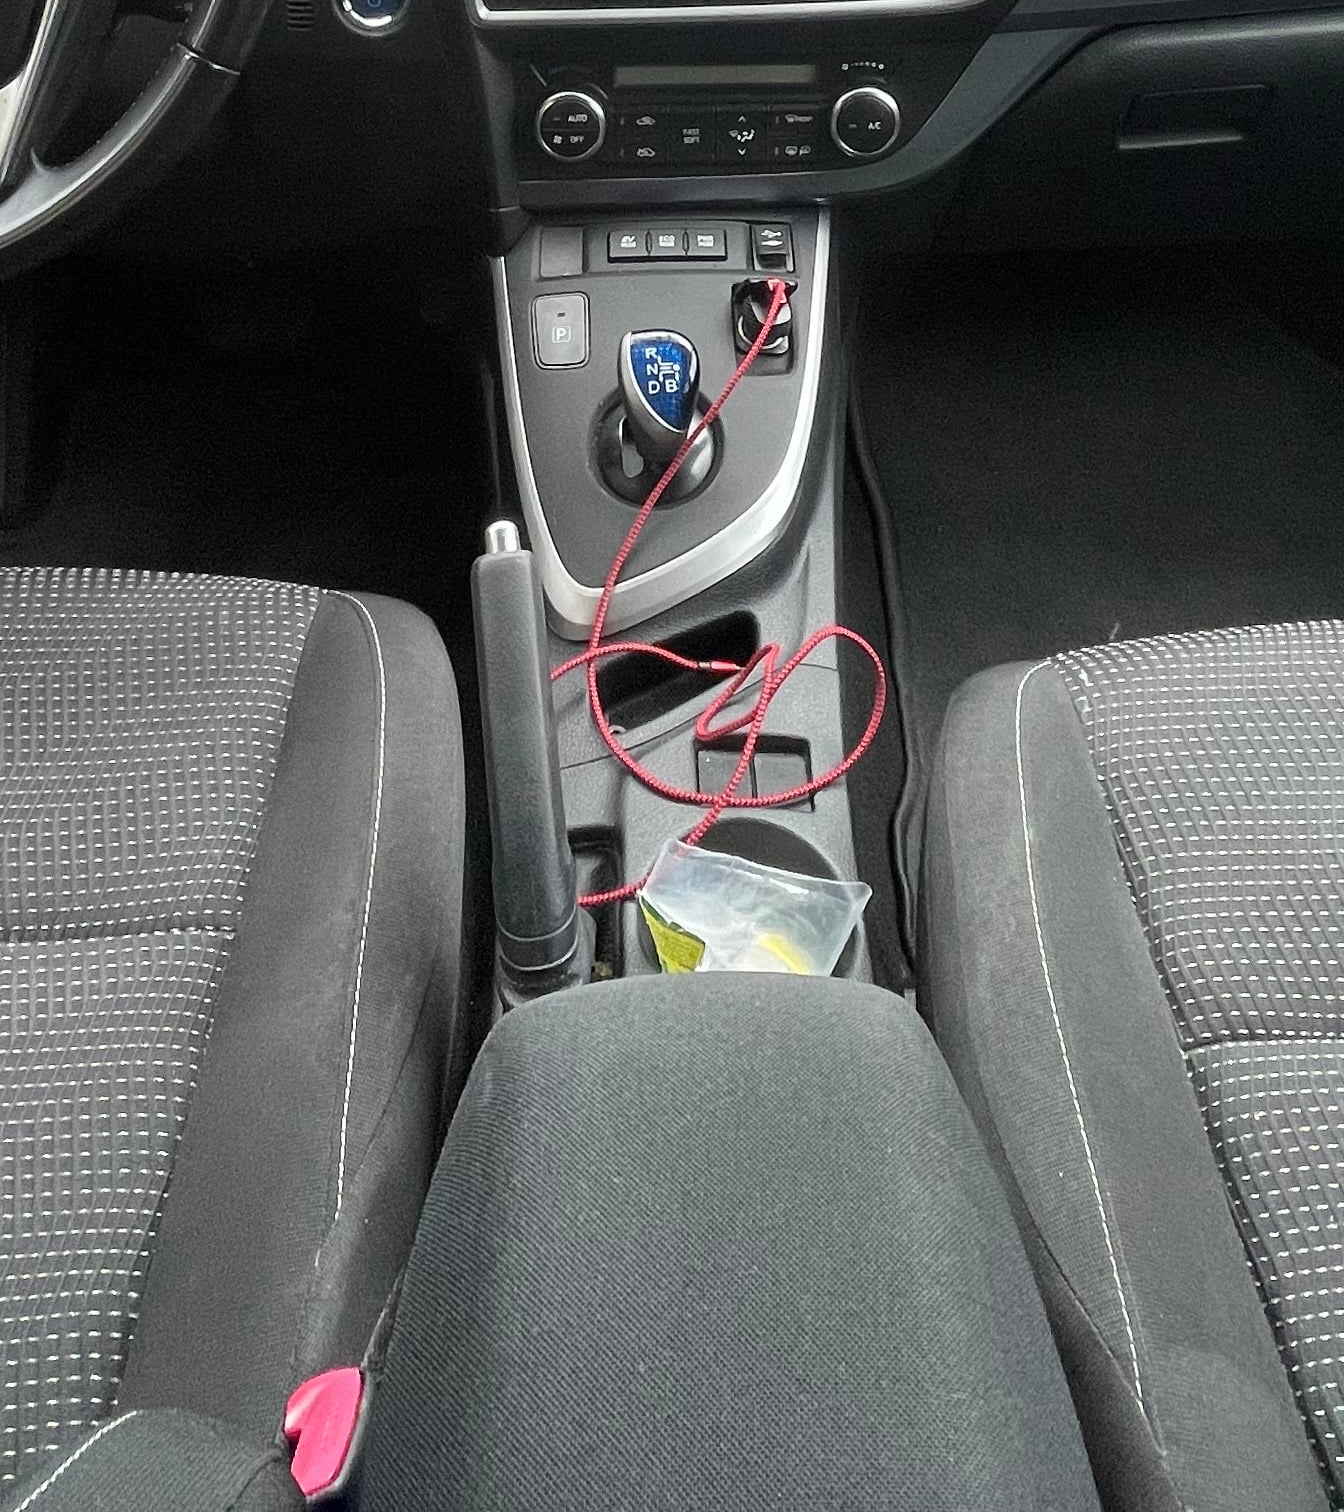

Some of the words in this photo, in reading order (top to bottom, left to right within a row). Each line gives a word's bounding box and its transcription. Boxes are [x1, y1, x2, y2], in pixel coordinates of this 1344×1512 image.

[567, 113, 588, 123] AUTO
[569, 135, 585, 144] OFF
[556, 327, 567, 341] P
[645, 347, 657, 360] R
[646, 363, 658, 376] N
[648, 381, 660, 395] D
[665, 379, 678, 393] B
